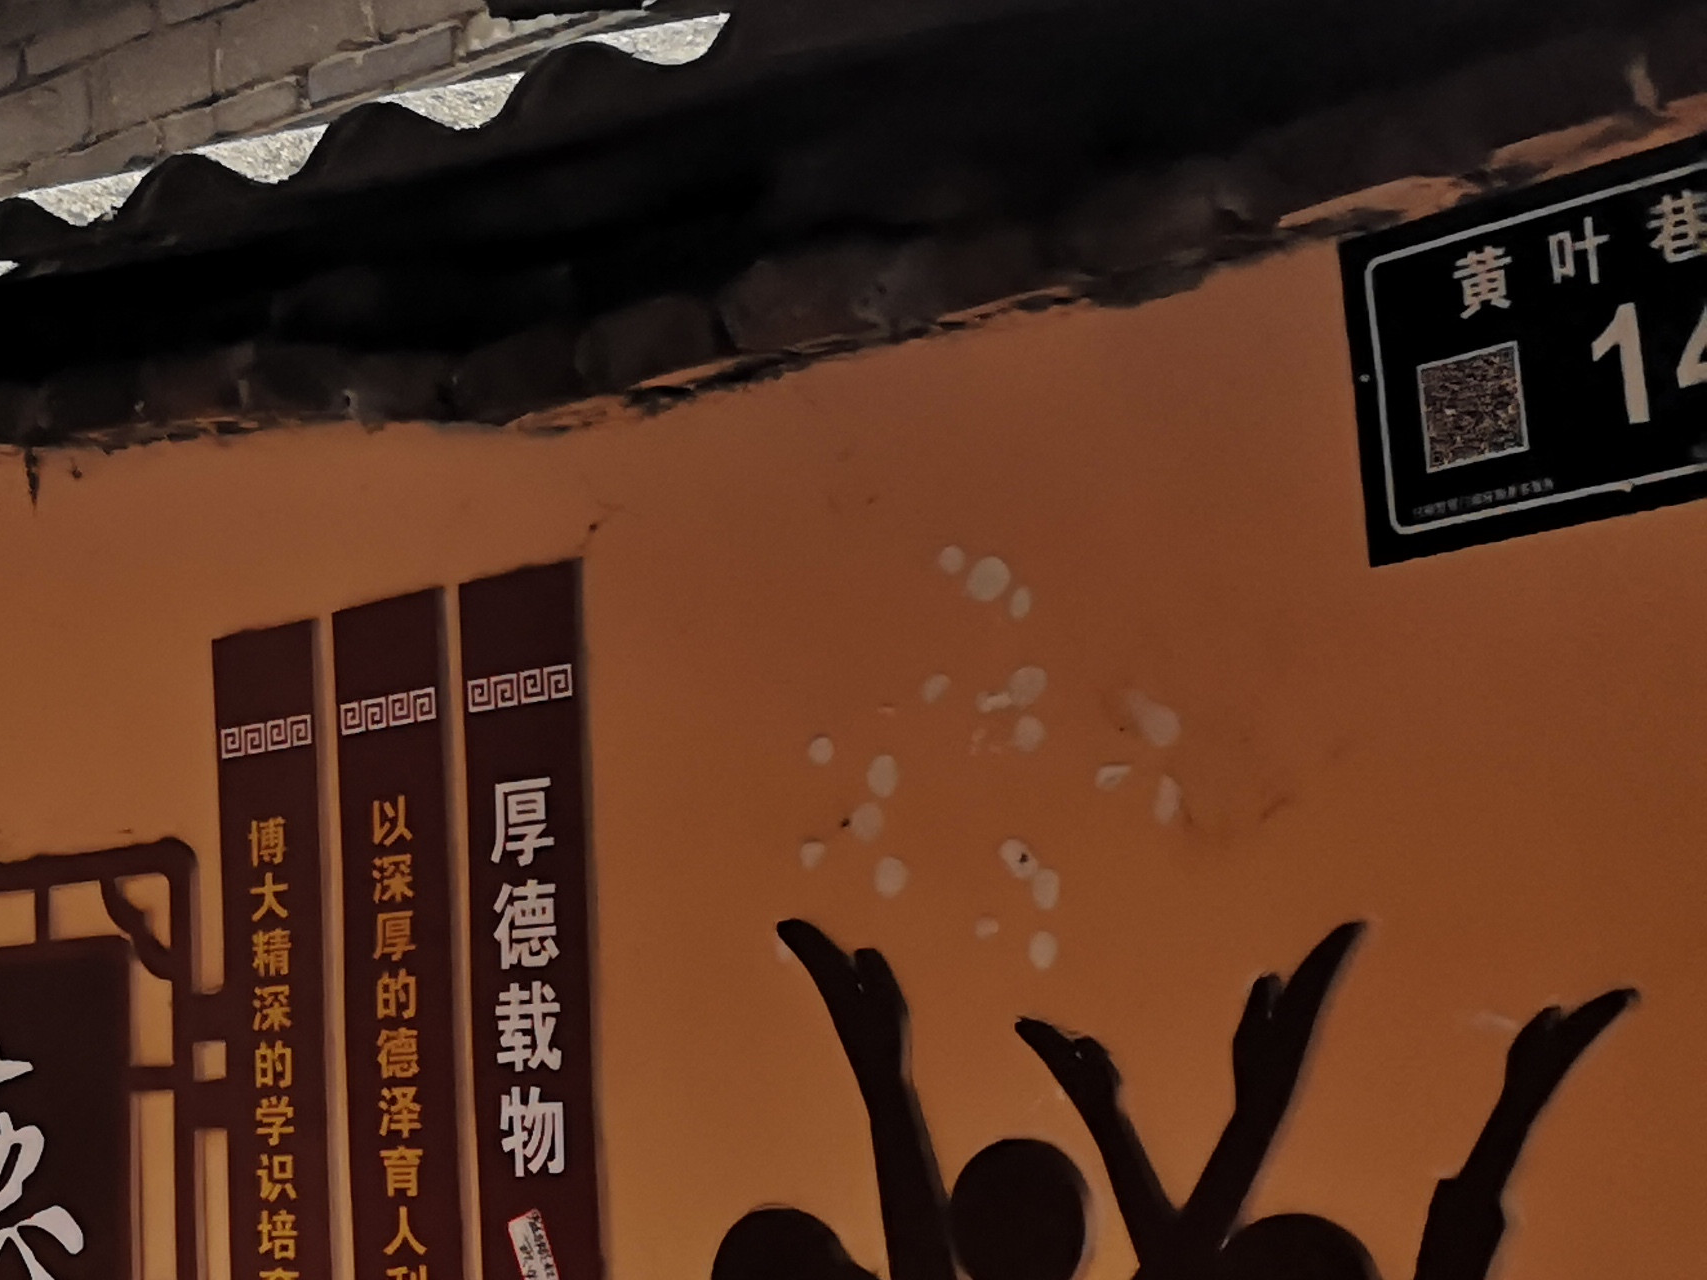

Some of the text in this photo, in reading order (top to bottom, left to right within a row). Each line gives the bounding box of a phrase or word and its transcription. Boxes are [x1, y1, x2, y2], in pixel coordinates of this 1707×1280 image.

[1453, 189, 1707, 320] 黄叶巷
[489, 775, 566, 1181] 厚德载物
